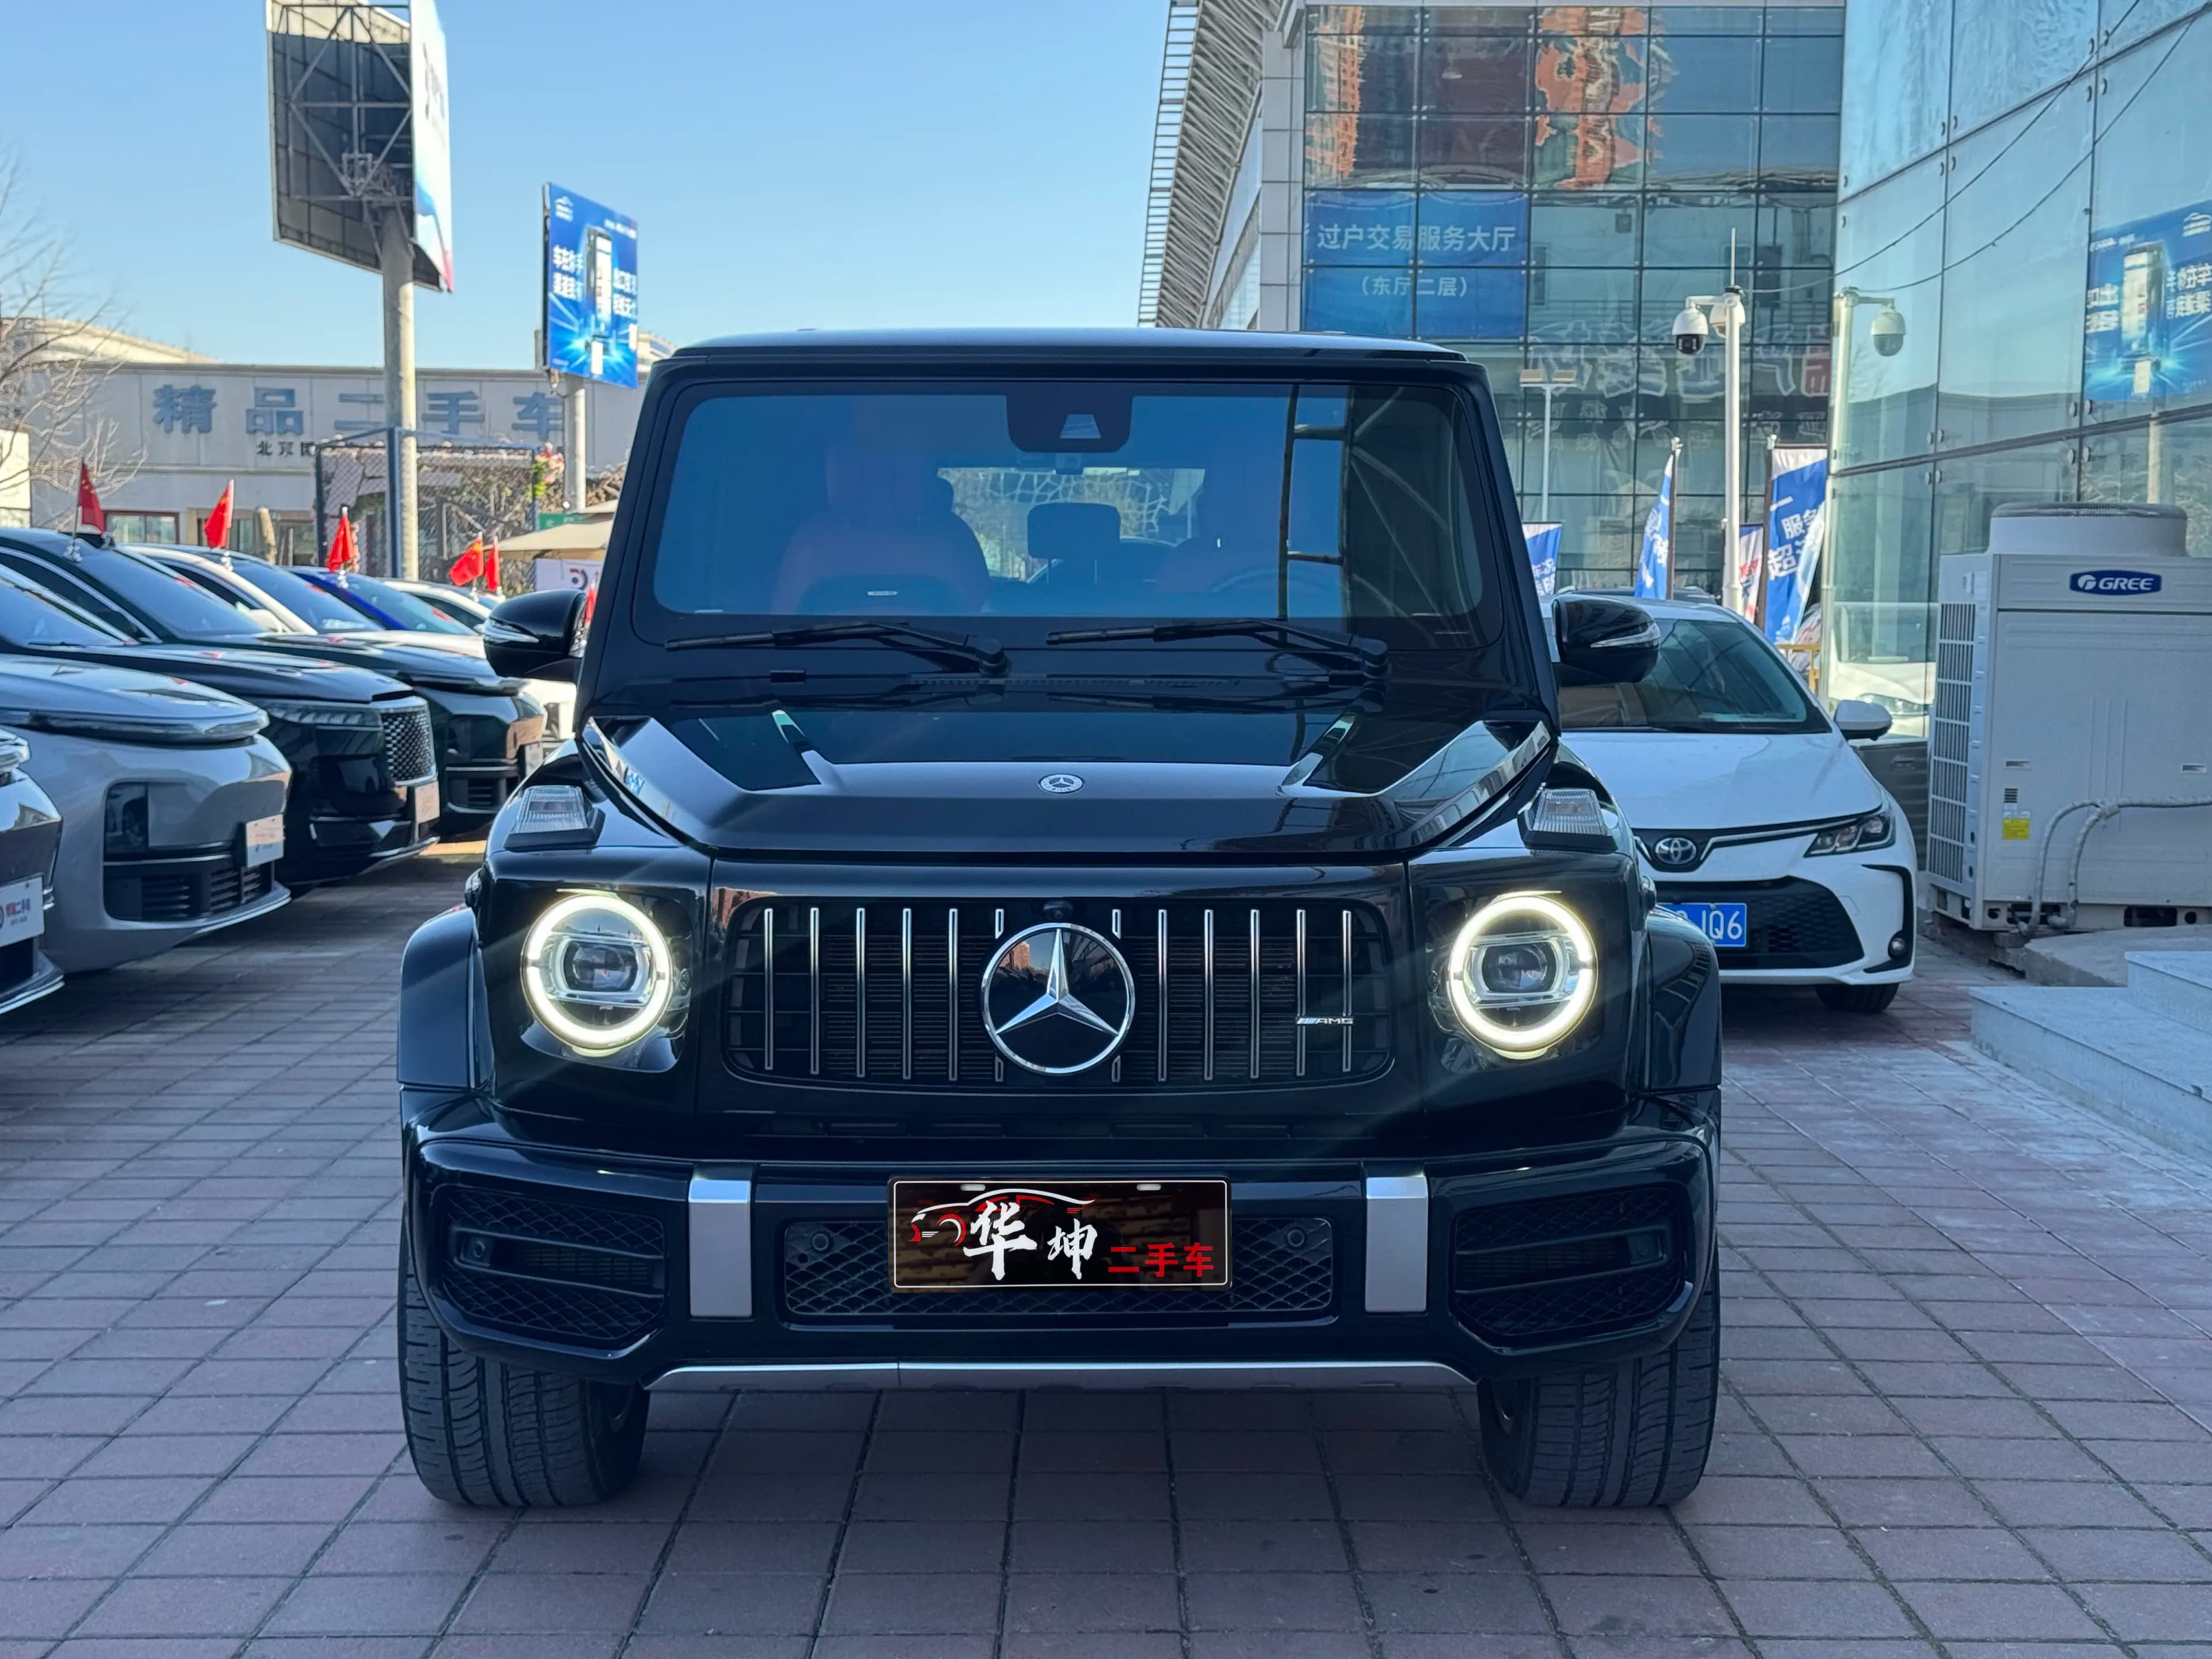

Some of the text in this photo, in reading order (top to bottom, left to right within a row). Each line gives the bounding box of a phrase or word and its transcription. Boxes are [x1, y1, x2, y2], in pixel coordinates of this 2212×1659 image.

[1317, 224, 1516, 251] 过户交易服务大厅
[152, 384, 563, 440] 精品二手车
[2099, 577, 2154, 590] GREE
[963, 1200, 1214, 1280] 华坤 二手车
